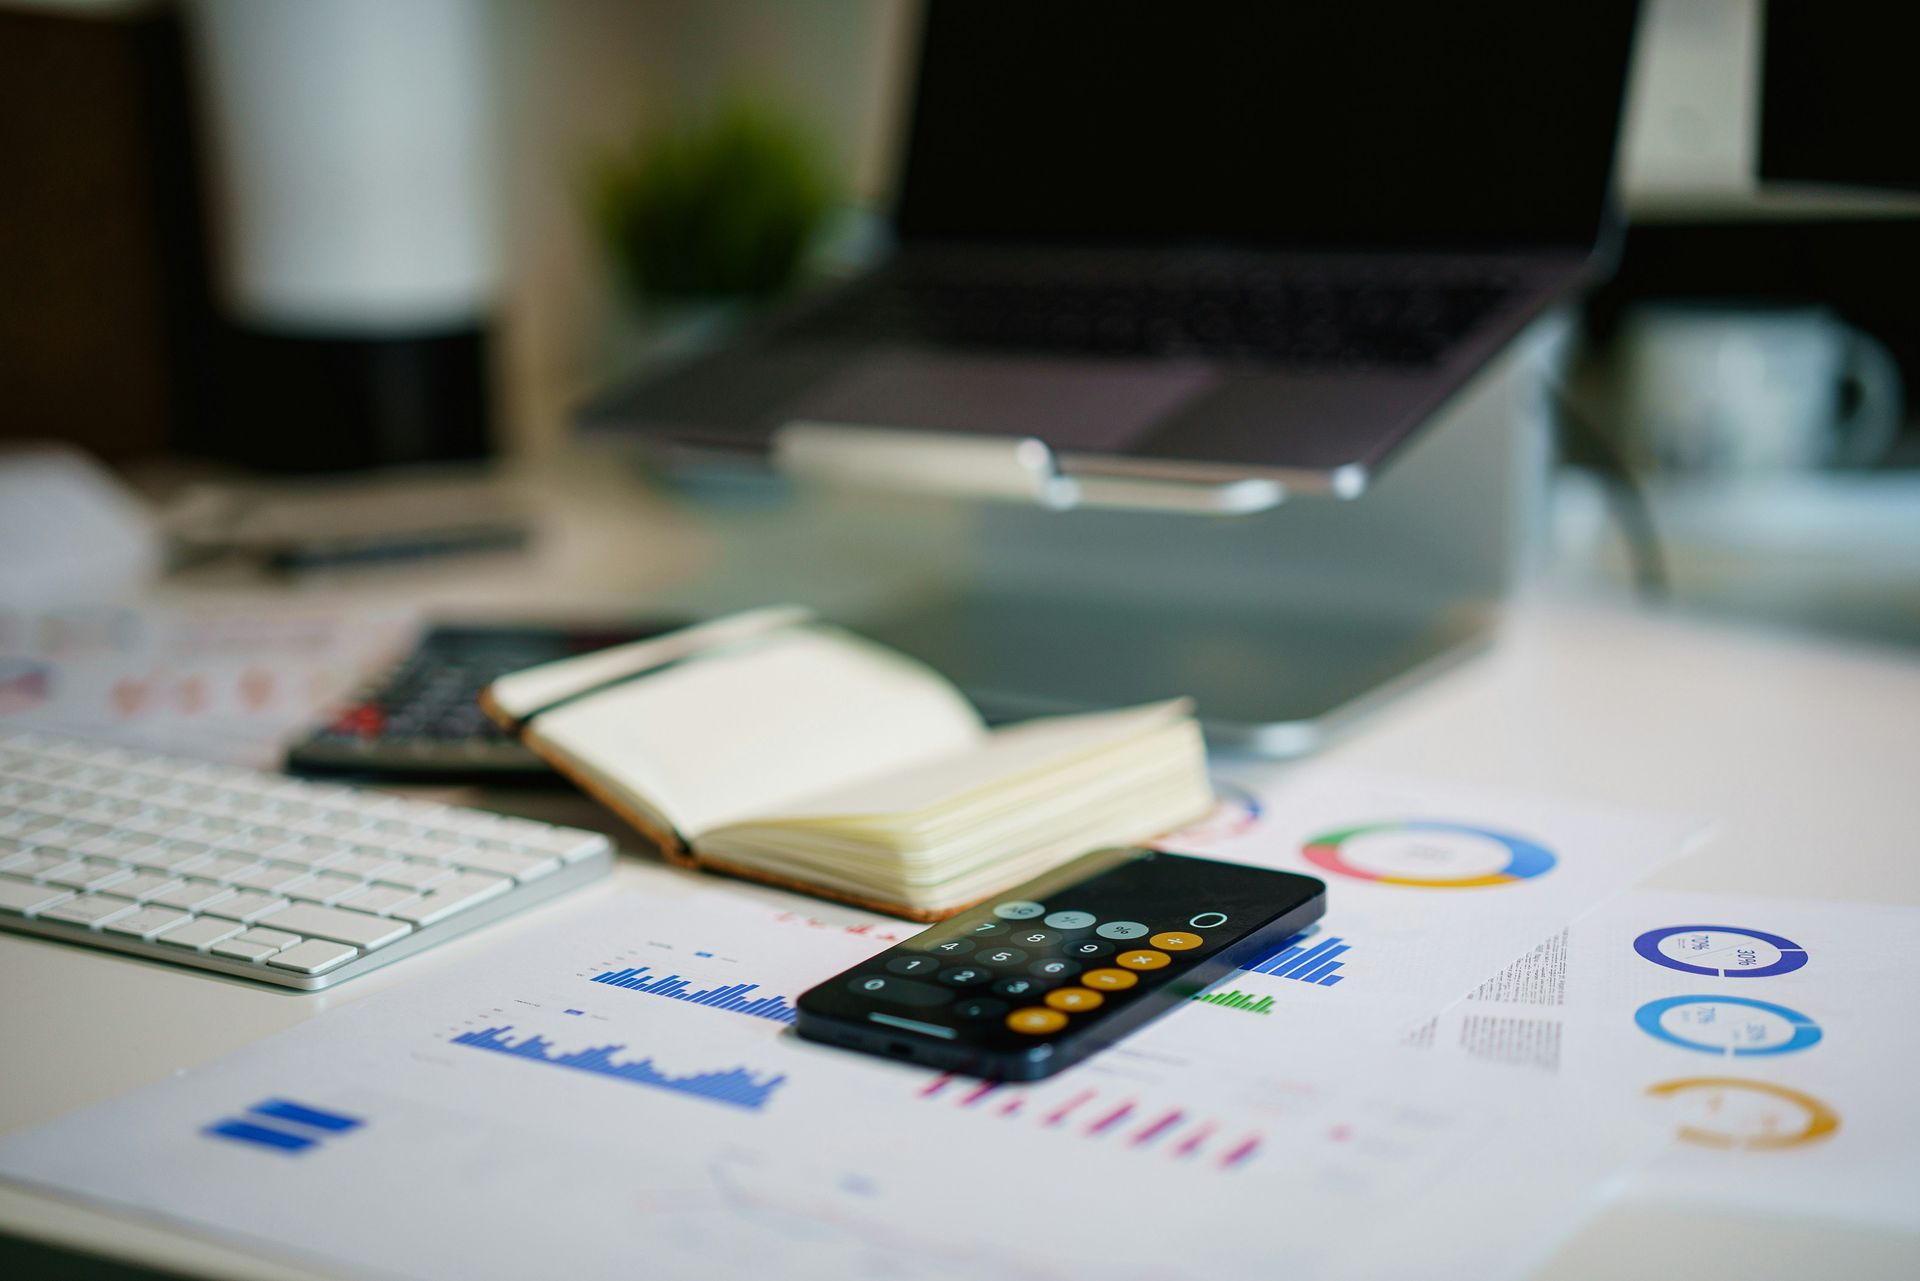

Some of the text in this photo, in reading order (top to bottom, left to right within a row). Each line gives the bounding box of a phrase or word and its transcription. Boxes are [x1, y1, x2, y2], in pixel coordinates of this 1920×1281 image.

[1189, 912, 1228, 929] 0
[975, 923, 996, 932] 7
[1026, 933, 1046, 943] 8
[940, 942, 960, 951] 4
[1079, 943, 1099, 954] 9
[991, 952, 1012, 962] 5
[1737, 949, 1757, 966] 30%
[906, 960, 921, 970] 1
[1044, 962, 1065, 973] 6
[953, 970, 976, 982] 2
[863, 978, 886, 991] 0
